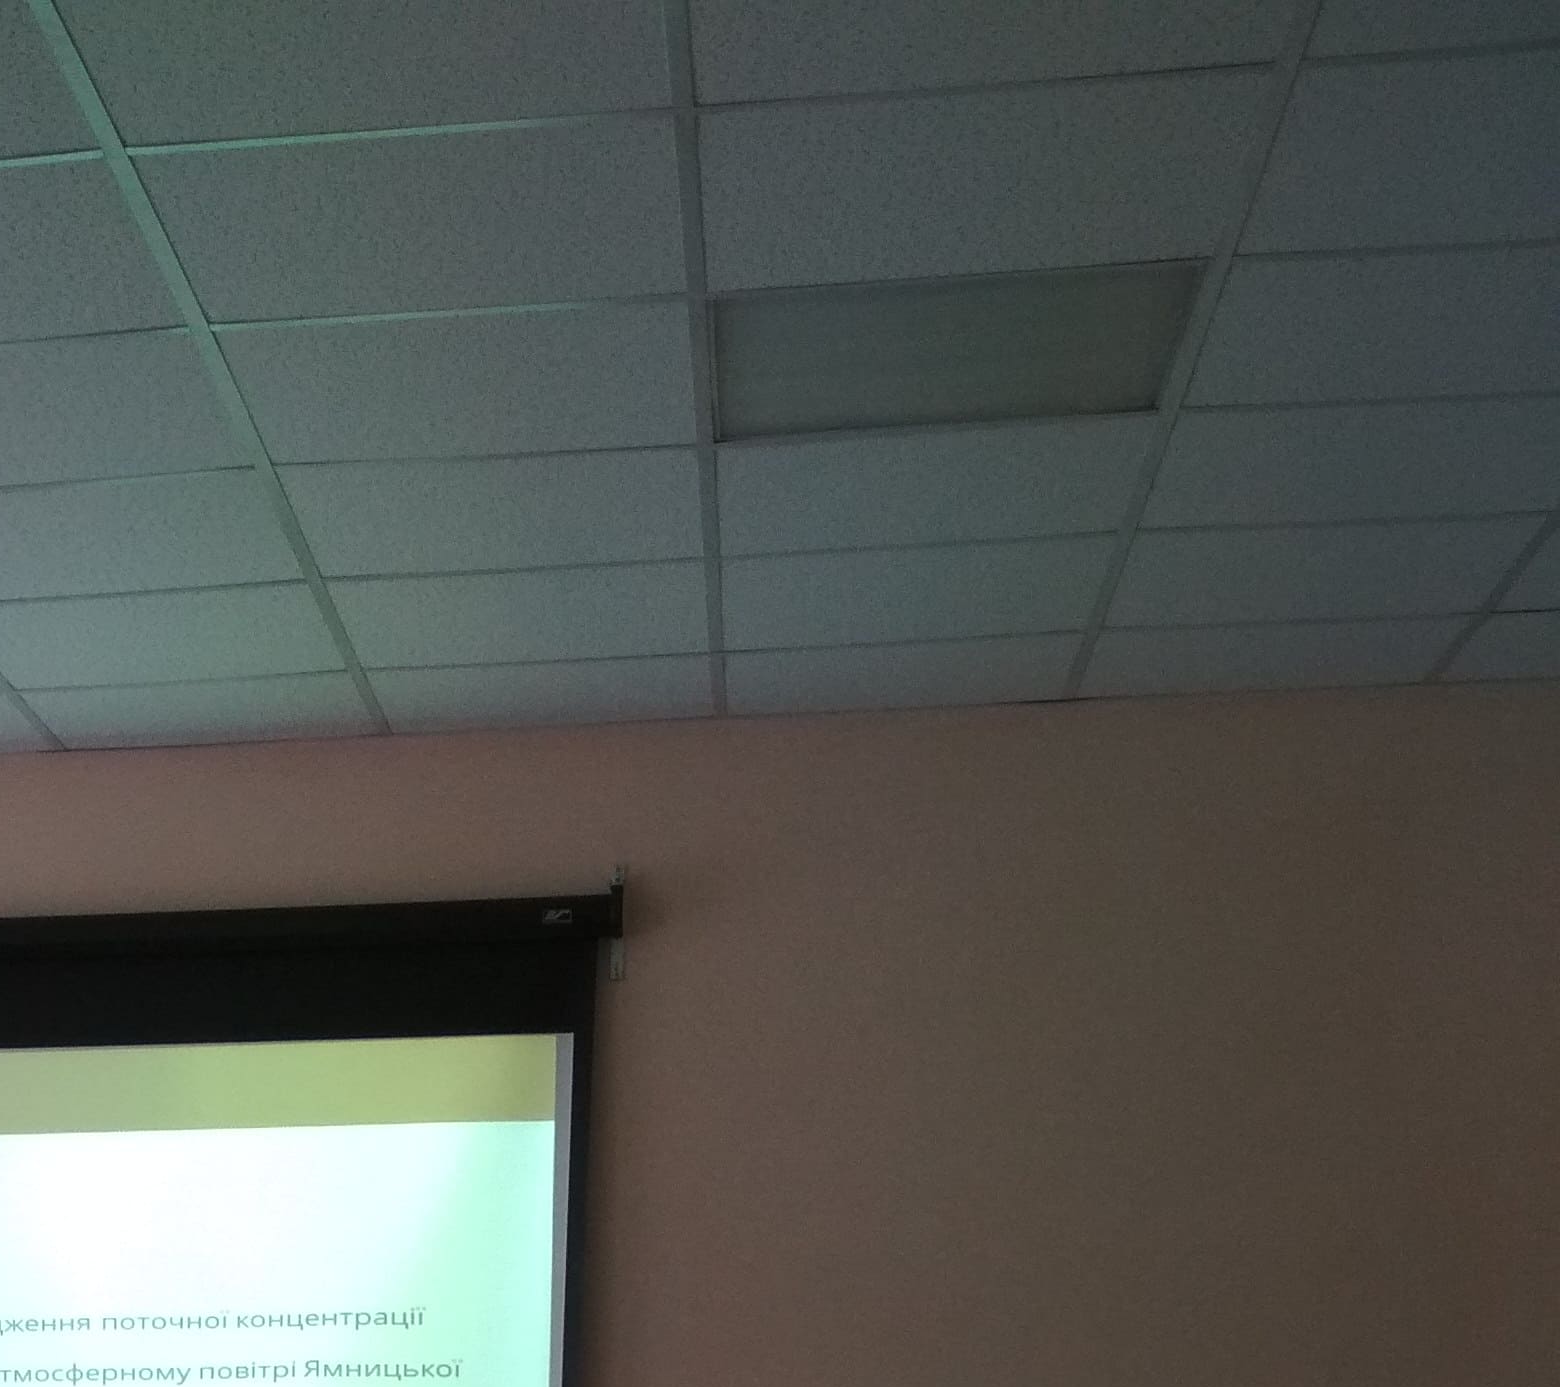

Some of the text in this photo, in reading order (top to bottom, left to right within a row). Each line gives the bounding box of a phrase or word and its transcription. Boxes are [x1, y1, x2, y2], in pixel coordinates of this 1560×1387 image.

[101, 1308, 230, 1332] поточної
[236, 1306, 427, 1332] концентрації
[199, 1359, 296, 1384] повітрі
[303, 1358, 464, 1382] Ямницької
